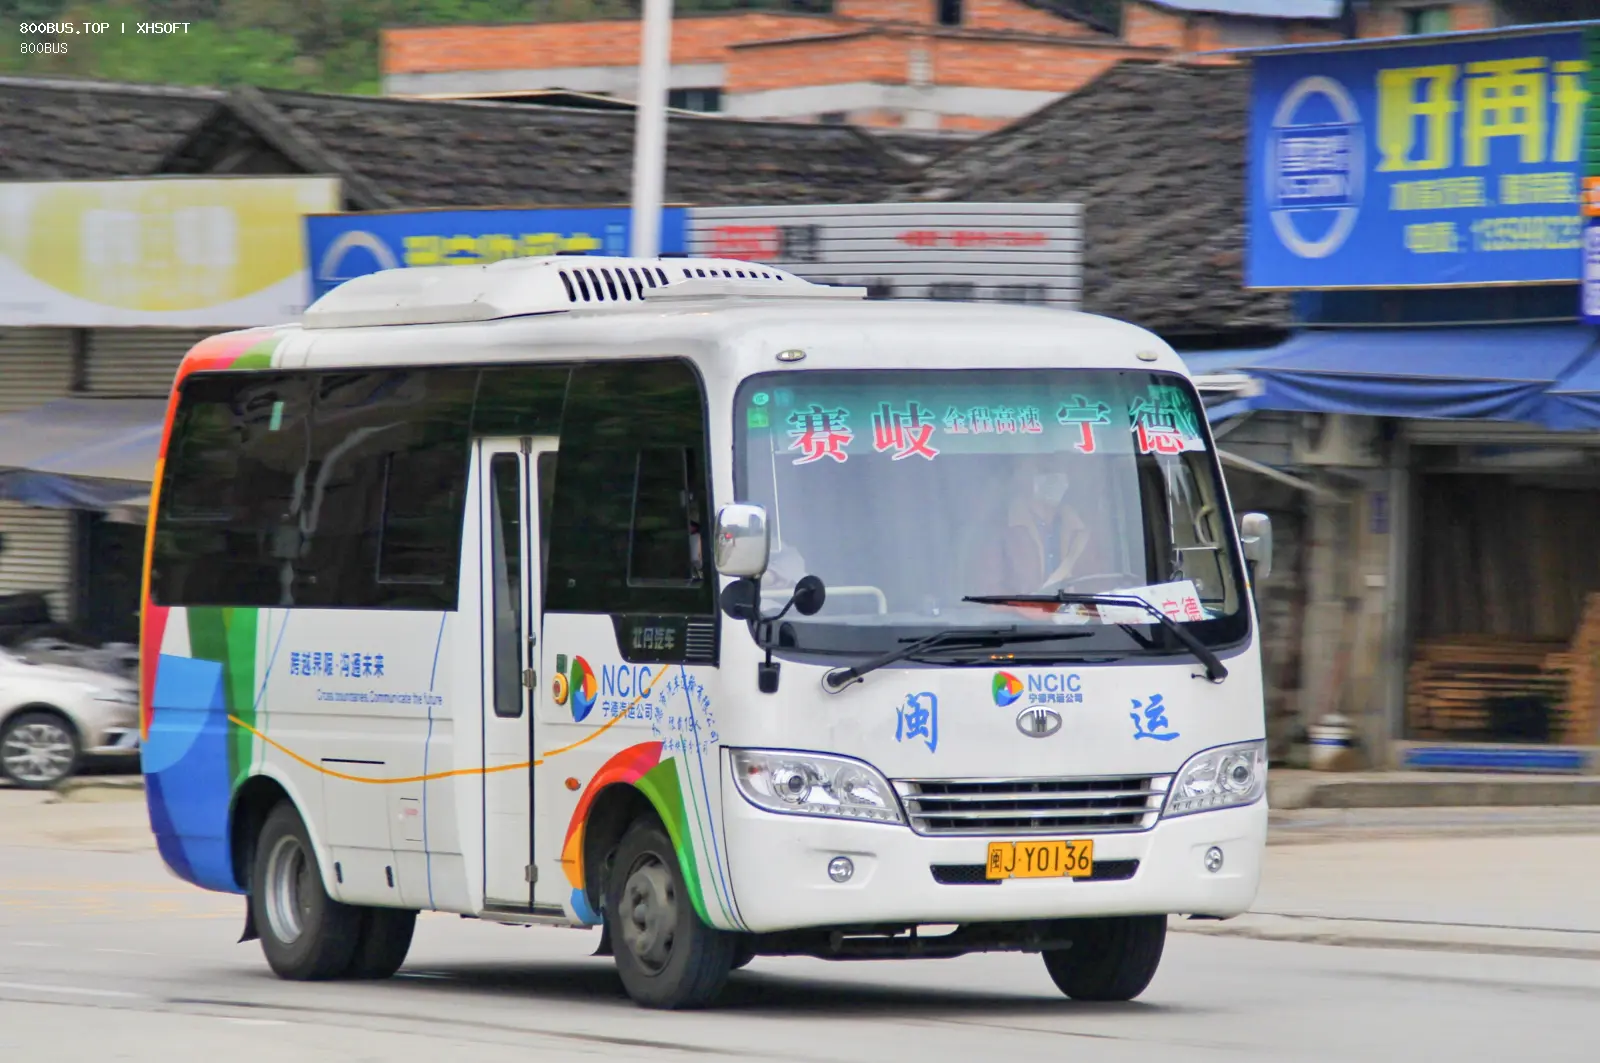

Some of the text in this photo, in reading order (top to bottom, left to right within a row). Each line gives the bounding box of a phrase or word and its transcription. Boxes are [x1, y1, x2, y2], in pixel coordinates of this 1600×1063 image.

[944, 405, 1044, 435] 全程高速
[1056, 394, 1184, 455] 宁德
[602, 664, 652, 699] NCIC
[1028, 674, 1081, 692] NCIC
[602, 701, 653, 721] 宁德汽运公司
[1028, 693, 1083, 703] 宁德汽运公司
[895, 691, 1180, 754] 闽 运
